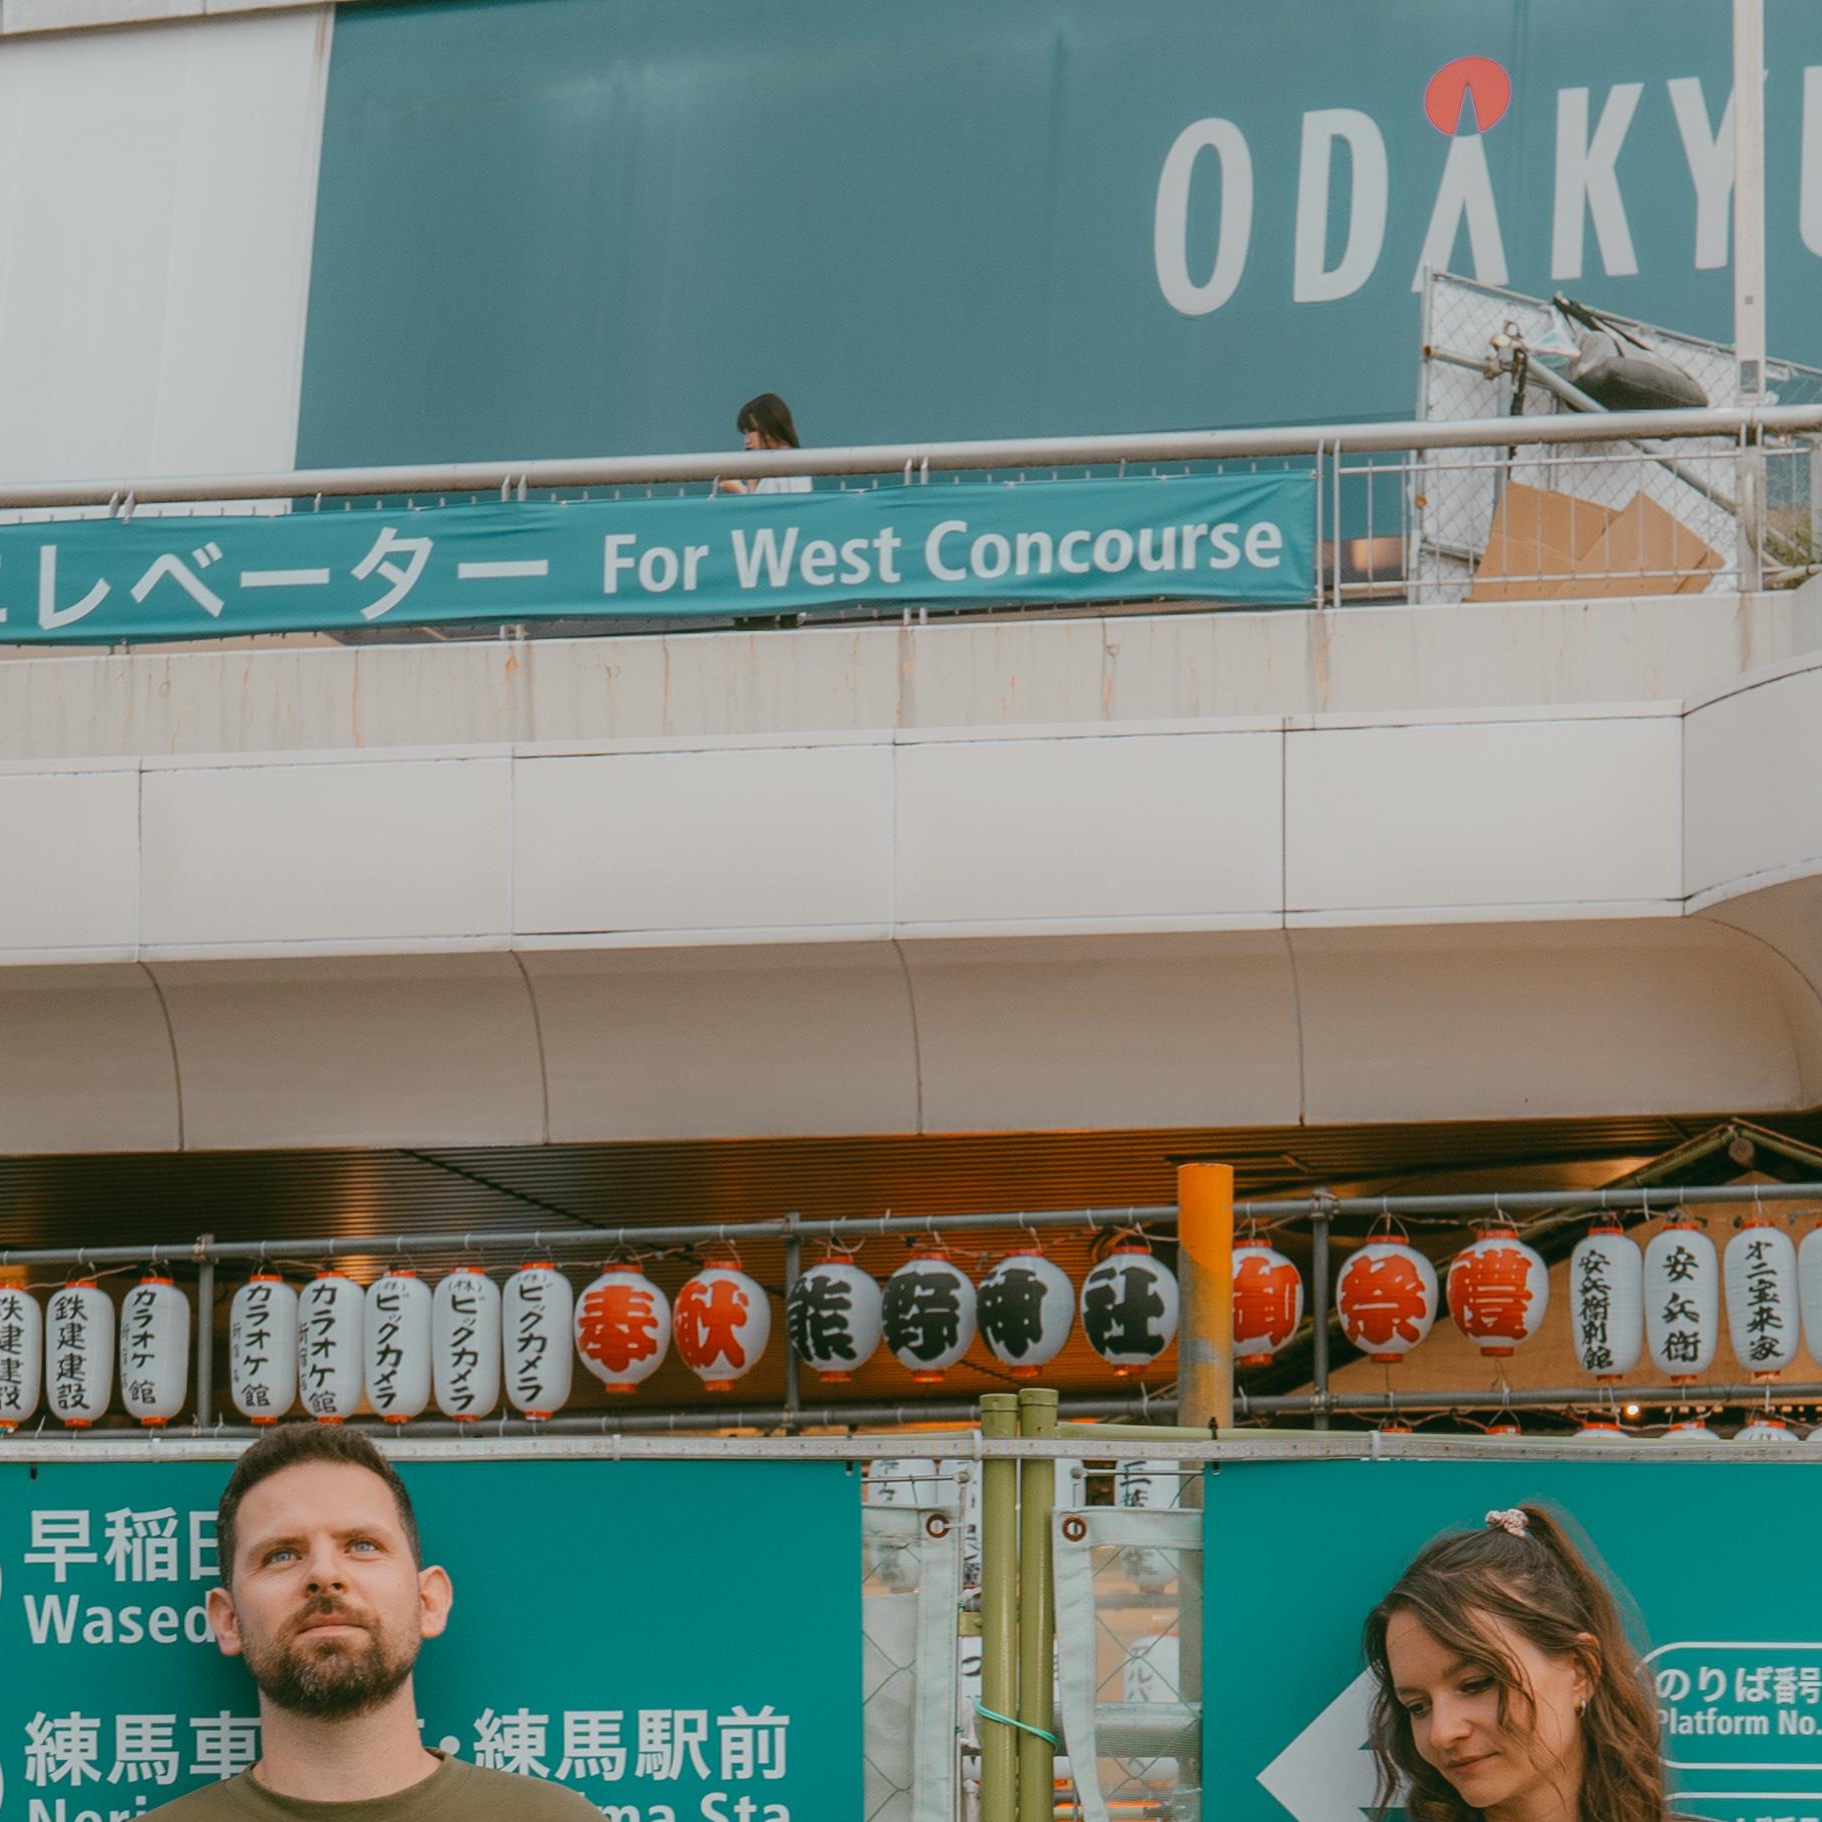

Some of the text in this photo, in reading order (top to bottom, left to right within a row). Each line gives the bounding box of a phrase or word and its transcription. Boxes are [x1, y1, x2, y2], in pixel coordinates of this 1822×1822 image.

[602, 517, 1283, 595] For West Concourse
[128, 1288, 157, 1405] カラオケ館
[241, 1285, 273, 1408] カラオケ館
[308, 1283, 337, 1414] カラオケ館
[23, 1590, 216, 1644] Wased
[1656, 1665, 1822, 1704] のりば番号
[1658, 1708, 1770, 1738] Platform
